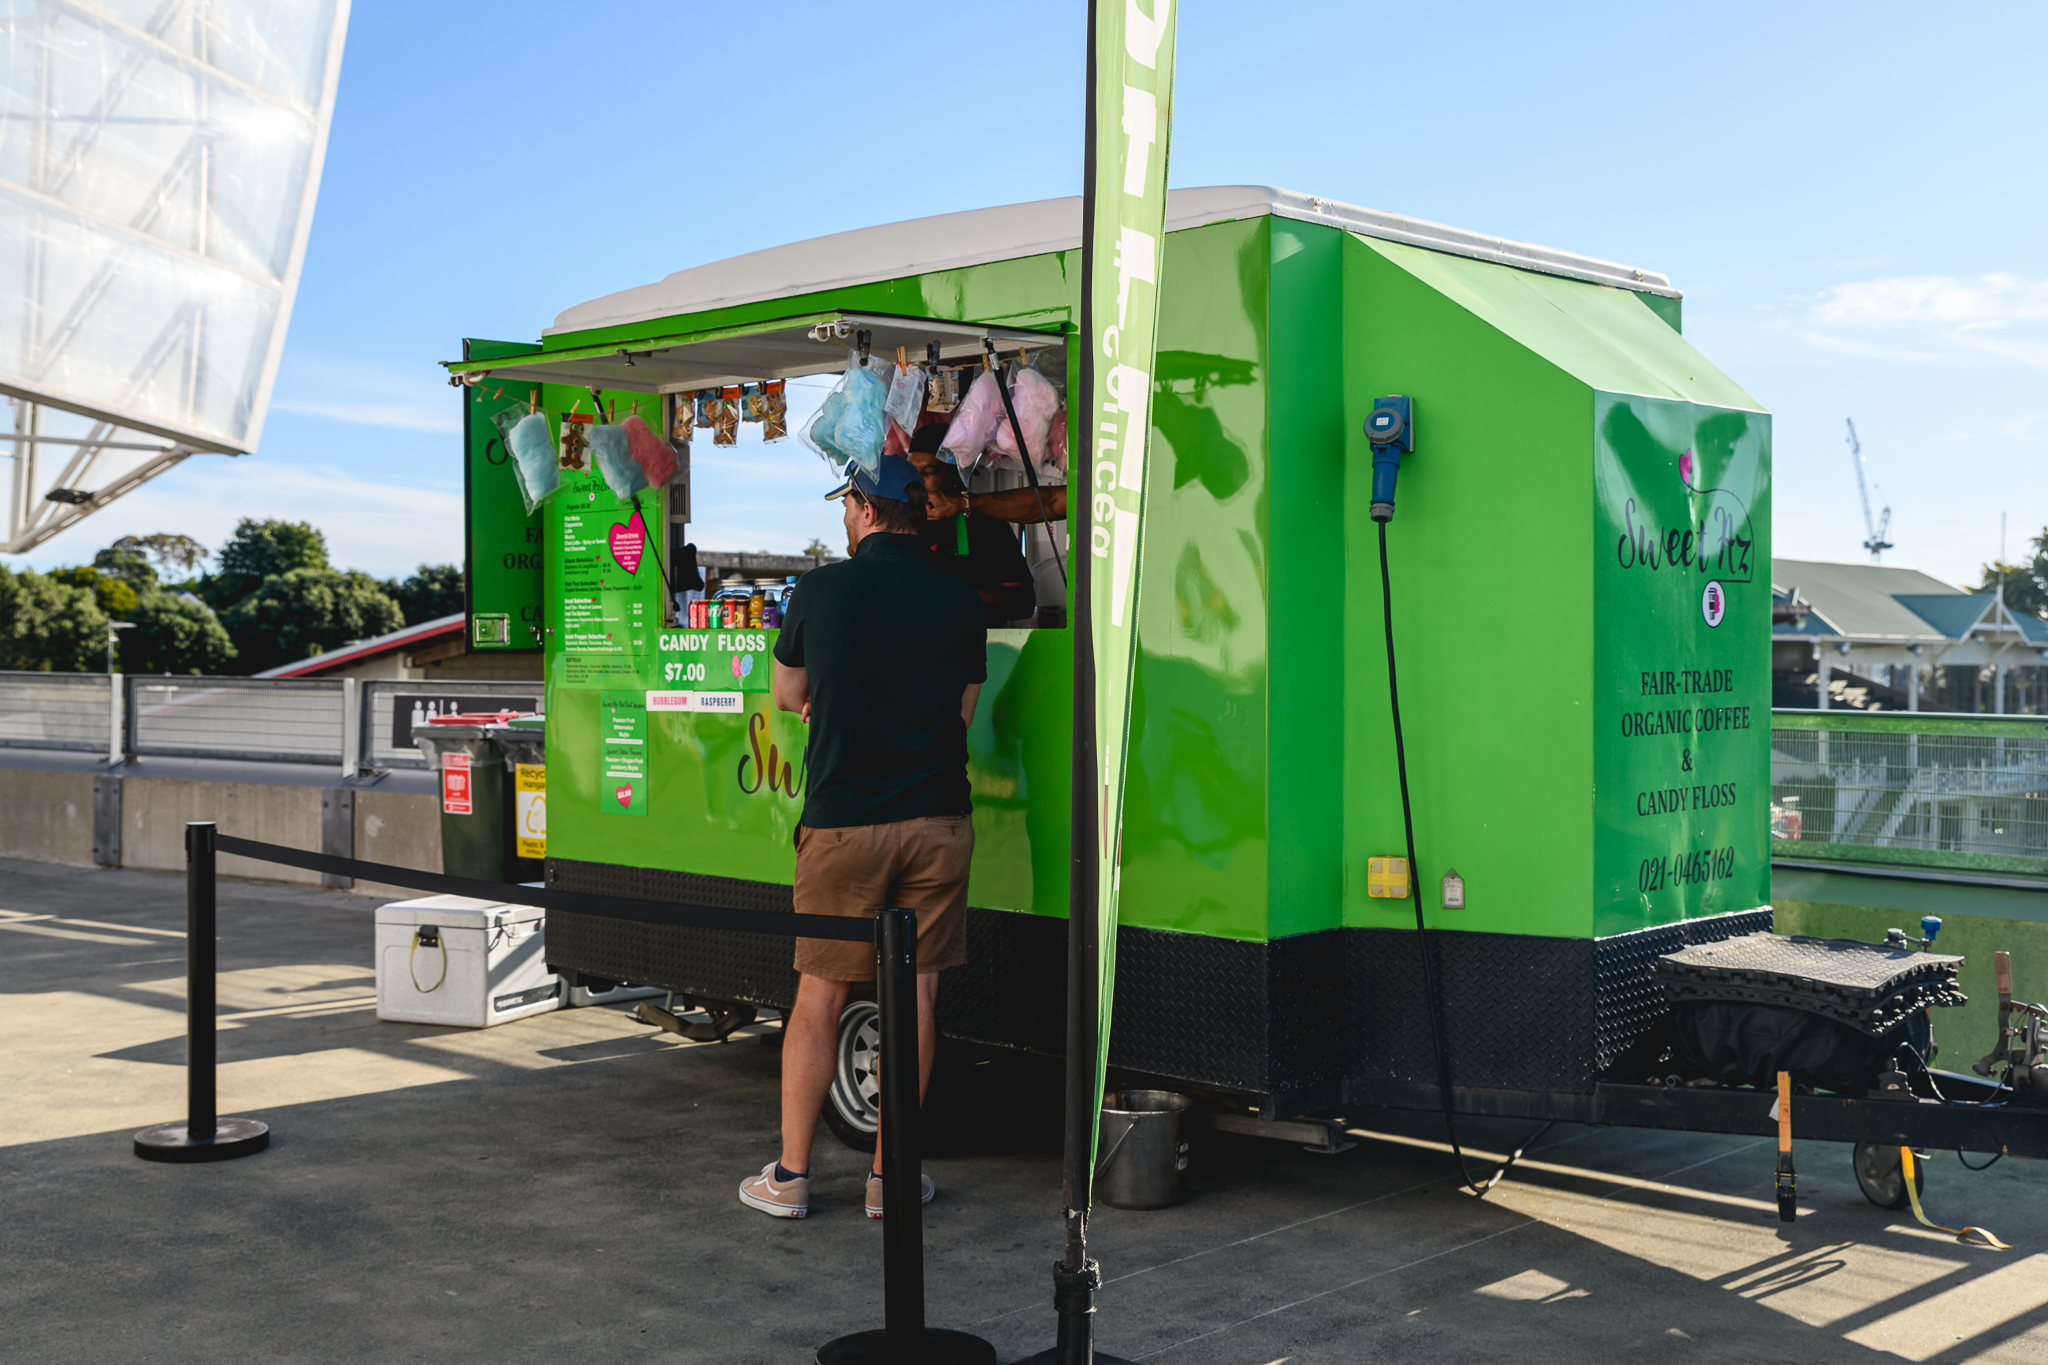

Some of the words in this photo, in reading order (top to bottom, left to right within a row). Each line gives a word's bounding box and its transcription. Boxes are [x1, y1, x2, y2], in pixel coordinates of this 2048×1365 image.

[1618, 498, 1709, 573] Sweet
[659, 634, 709, 651] CANDY
[717, 634, 766, 651] FLOSS
[664, 662, 706, 683] $7.00
[1641, 670, 1733, 695] FAIR-TRADE
[653, 697, 687, 705] BUBBLEGUM
[701, 697, 736, 707] RASPBERRY
[1621, 710, 1691, 737] ORGANIC
[1695, 706, 1750, 732] COFFEE
[1682, 749, 1693, 772] &
[1637, 788, 1689, 816] CANDY
[1692, 783, 1736, 810] FLOSS
[1639, 846, 1734, 893] 021-0465162
